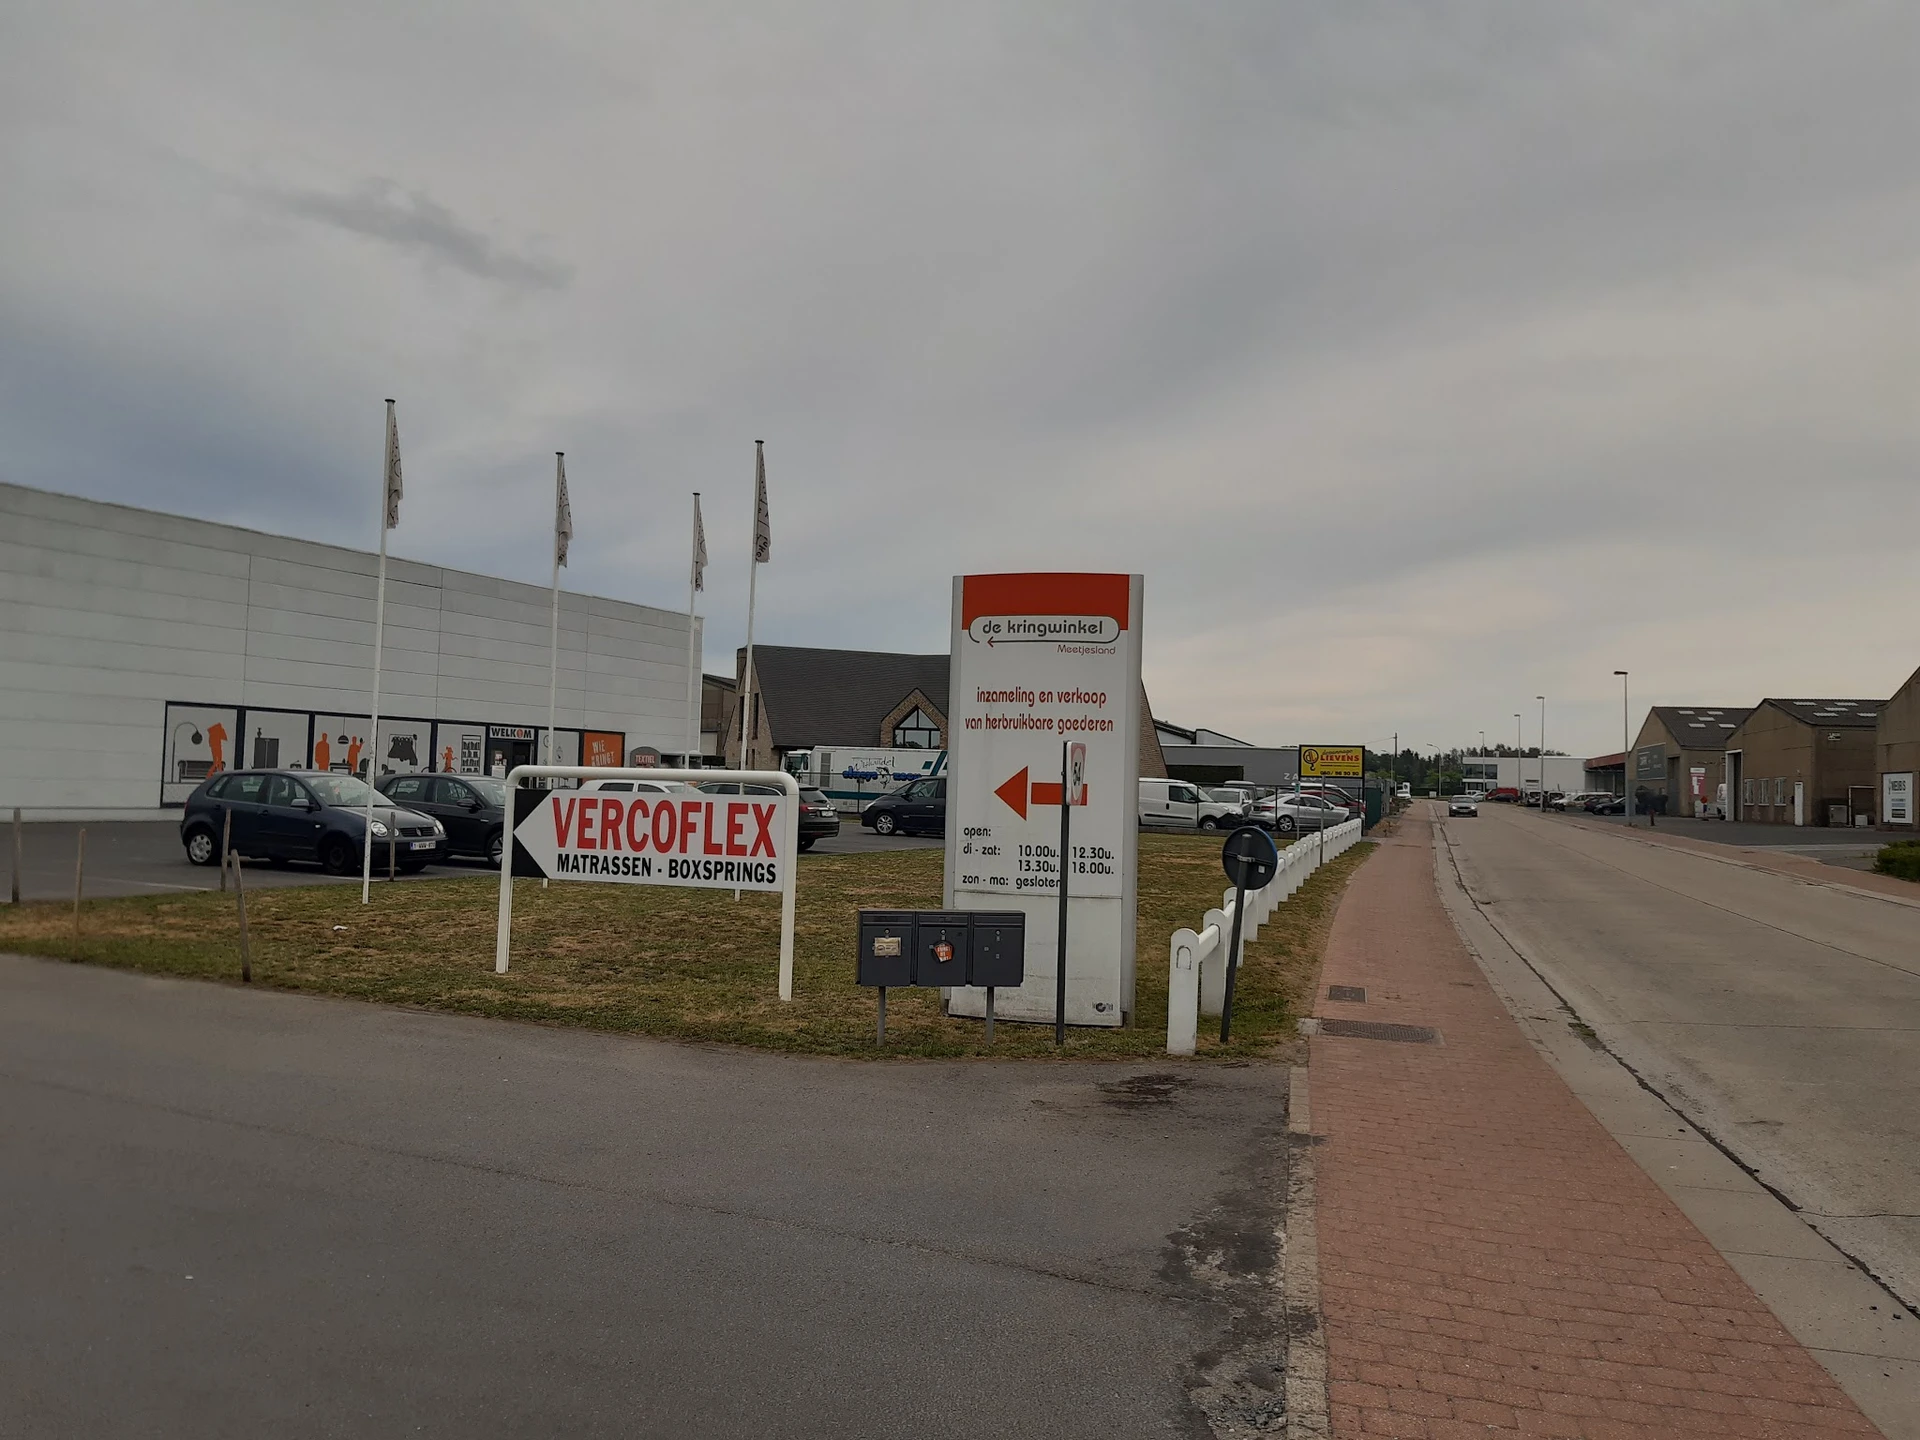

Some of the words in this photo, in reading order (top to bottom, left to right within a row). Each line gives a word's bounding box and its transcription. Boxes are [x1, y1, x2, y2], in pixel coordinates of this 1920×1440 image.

[982, 620, 1001, 634] de
[1007, 620, 1103, 637] kringwinkel
[1057, 644, 1116, 656] Meetjesland
[976, 686, 1035, 707] inzameling
[1038, 691, 1053, 704] en
[1057, 687, 1107, 709] verkoop
[965, 717, 982, 730] van
[985, 713, 1054, 730] herbruikbare
[1057, 715, 1114, 735] goederen
[491, 727, 532, 739] WELKOM
[592, 740, 606, 754] WIE
[635, 754, 656, 764] TEXTIEL
[552, 797, 777, 858] VERCOFLEX
[963, 827, 992, 839] open:
[963, 843, 972, 855] di
[981, 846, 1001, 856] zat:
[1018, 844, 1060, 858] 10.00u.
[1072, 846, 1115, 860] 12.30u.
[557, 853, 651, 877] MATRASSEN
[668, 859, 777, 884] BOXSPRINGS
[1018, 859, 1060, 873] 13.30u.
[1072, 861, 1115, 875] 18.00u.
[962, 874, 980, 885] zon
[989, 876, 1009, 886] ma:
